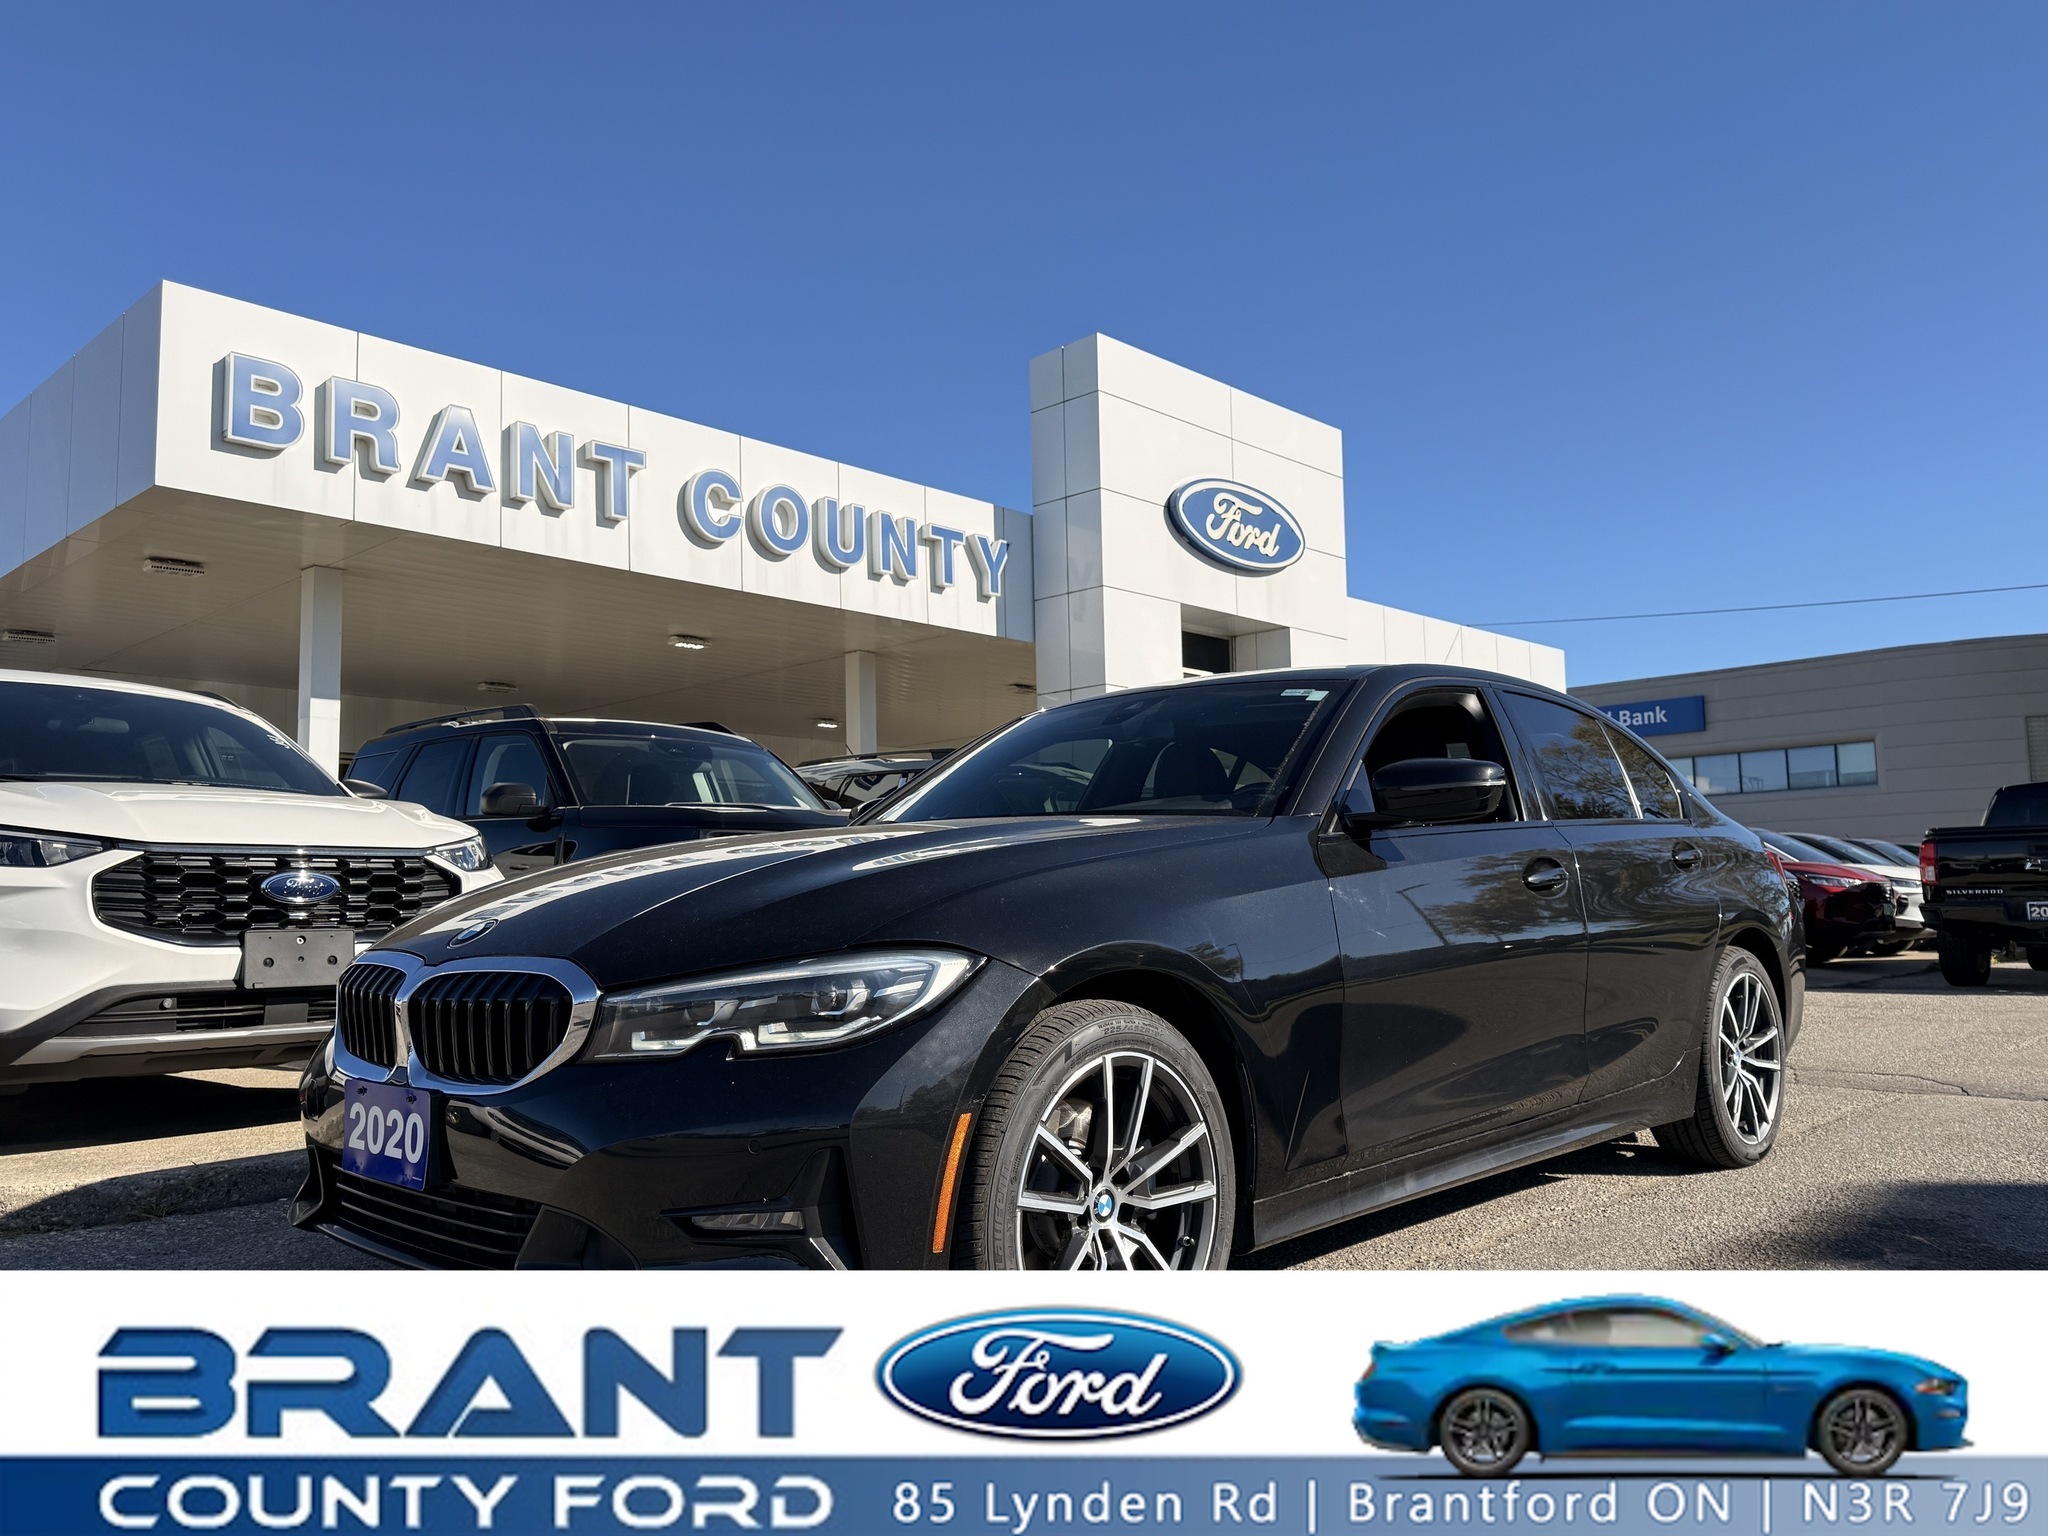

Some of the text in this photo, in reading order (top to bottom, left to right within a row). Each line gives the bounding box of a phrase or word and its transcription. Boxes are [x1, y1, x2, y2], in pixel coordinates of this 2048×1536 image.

[224, 351, 1009, 598] BRANT COUNTY
[1205, 492, 1281, 557] Ford
[1619, 706, 1668, 727] Bank
[1946, 888, 2004, 896] SILVERADO
[348, 1102, 425, 1164] 2020
